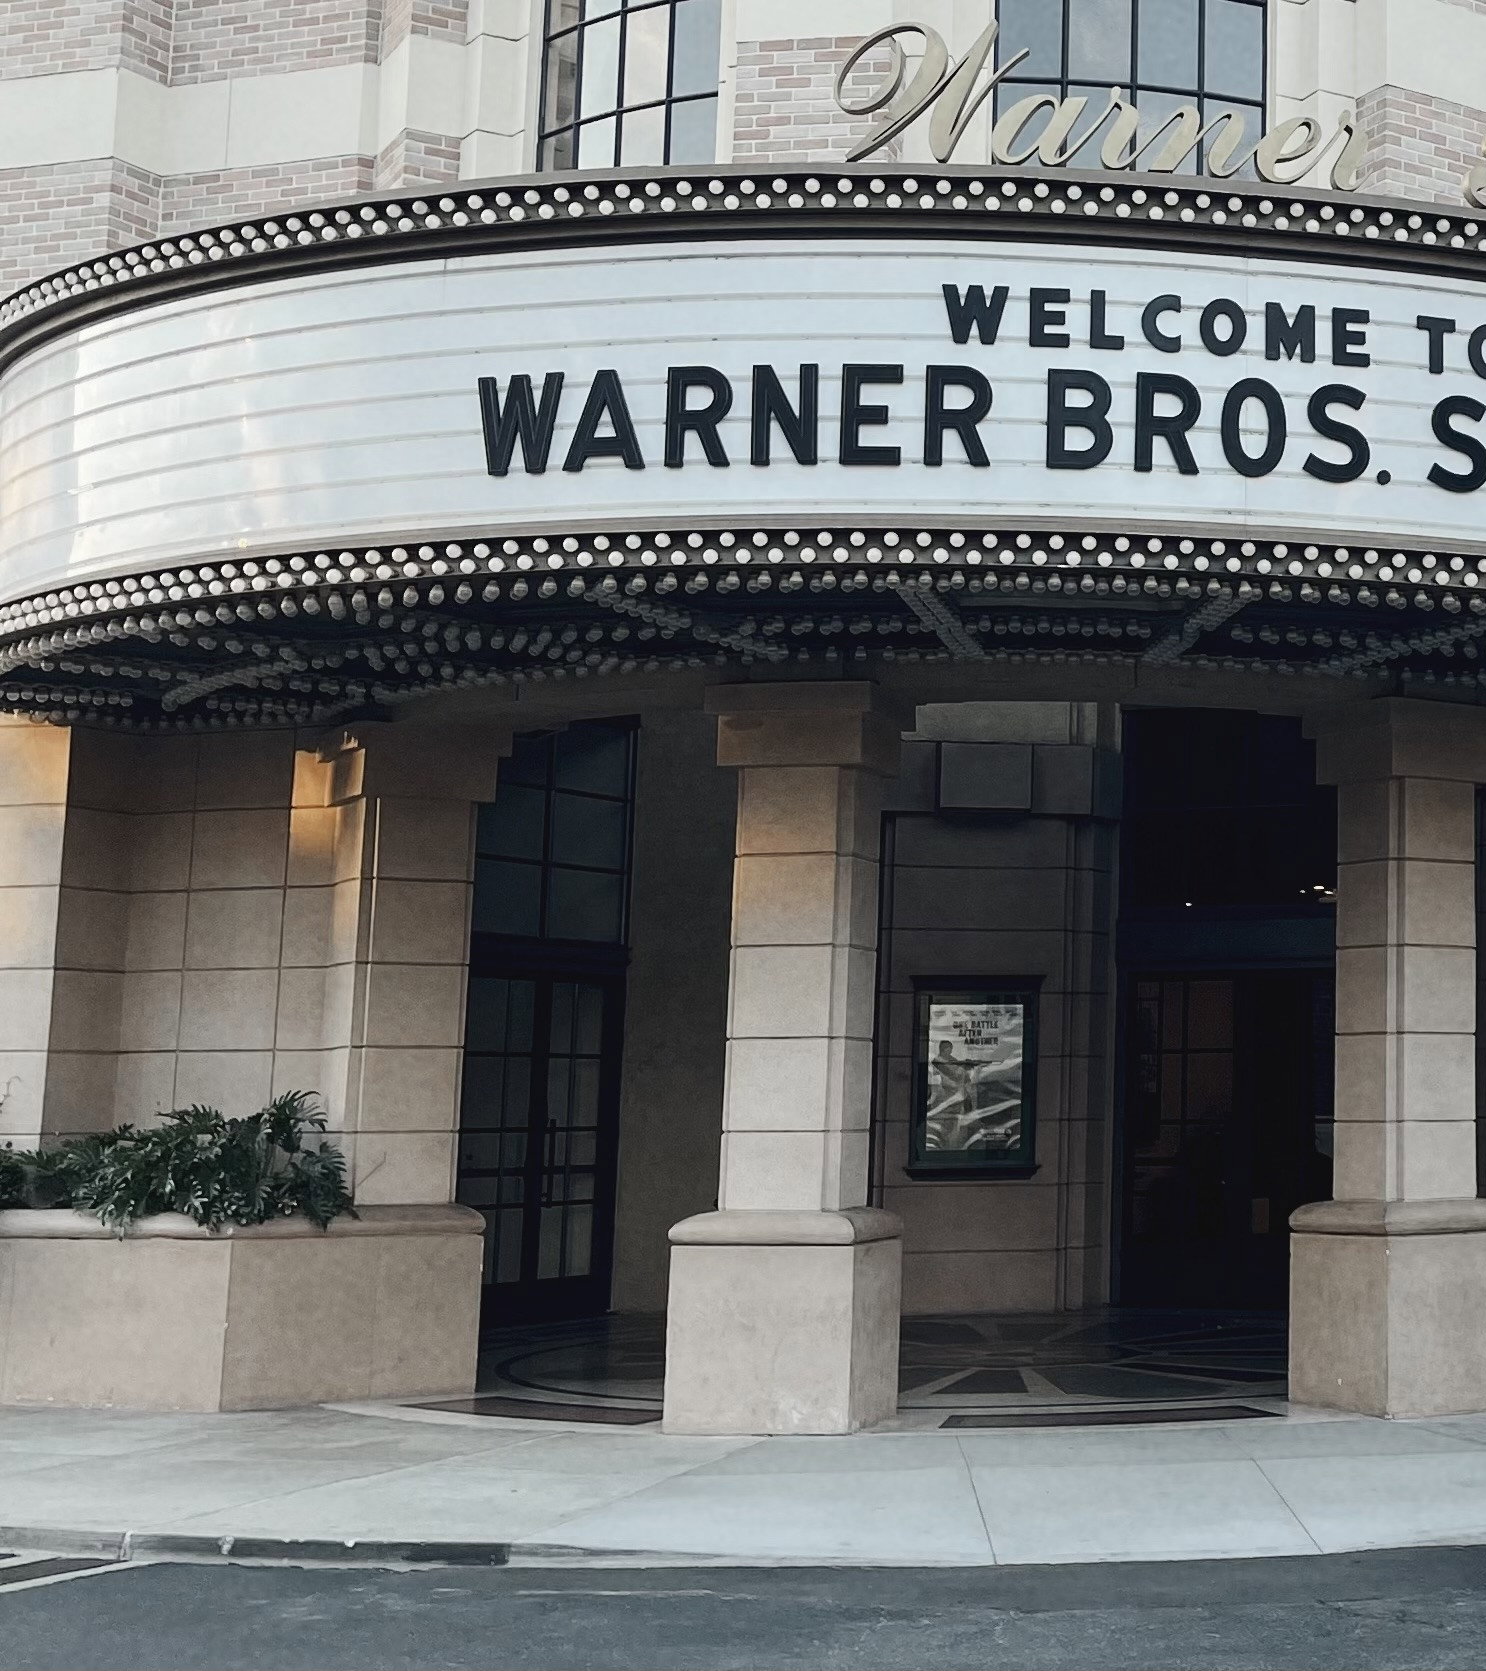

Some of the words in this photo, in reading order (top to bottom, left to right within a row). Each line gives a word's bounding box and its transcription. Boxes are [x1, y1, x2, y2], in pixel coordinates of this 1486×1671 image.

[836, 21, 1375, 191] Warner
[943, 284, 1371, 368] WELCOME
[477, 363, 993, 476] WARNER
[1046, 368, 1392, 485] BROS.
